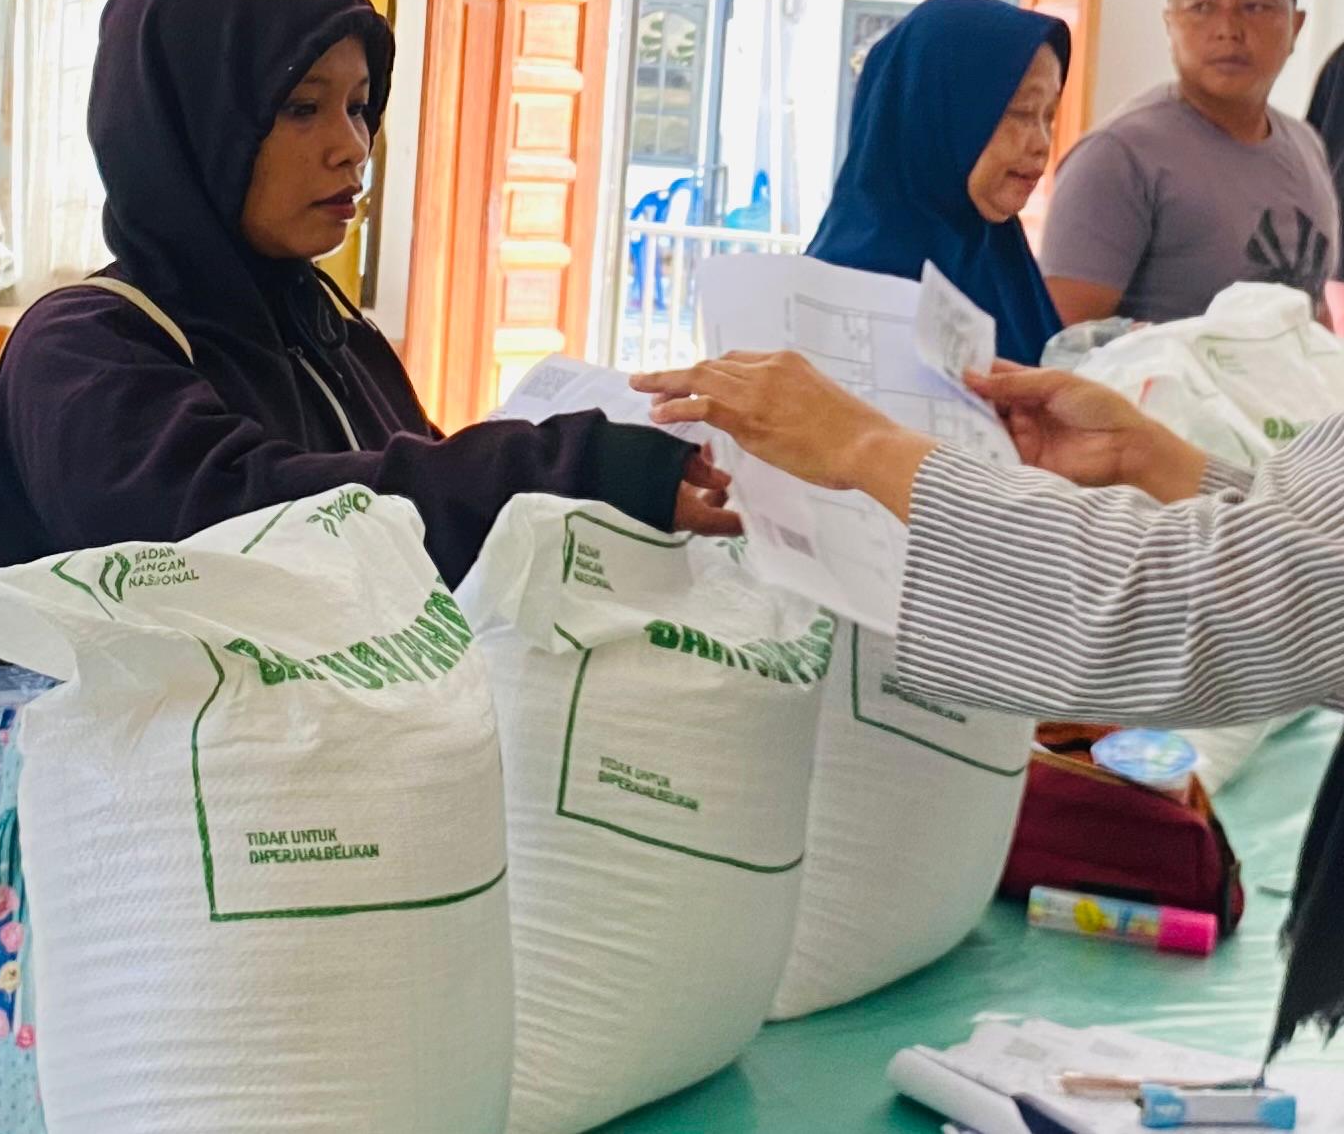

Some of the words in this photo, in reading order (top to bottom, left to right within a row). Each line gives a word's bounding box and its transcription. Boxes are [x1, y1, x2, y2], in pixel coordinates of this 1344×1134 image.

[133, 557, 186, 575] NGAN
[127, 569, 200, 588] NASIONAL
[246, 831, 288, 846] TIDAK
[290, 828, 338, 844] UNTUK
[248, 844, 380, 864] DIPERJUALBELIKAN
